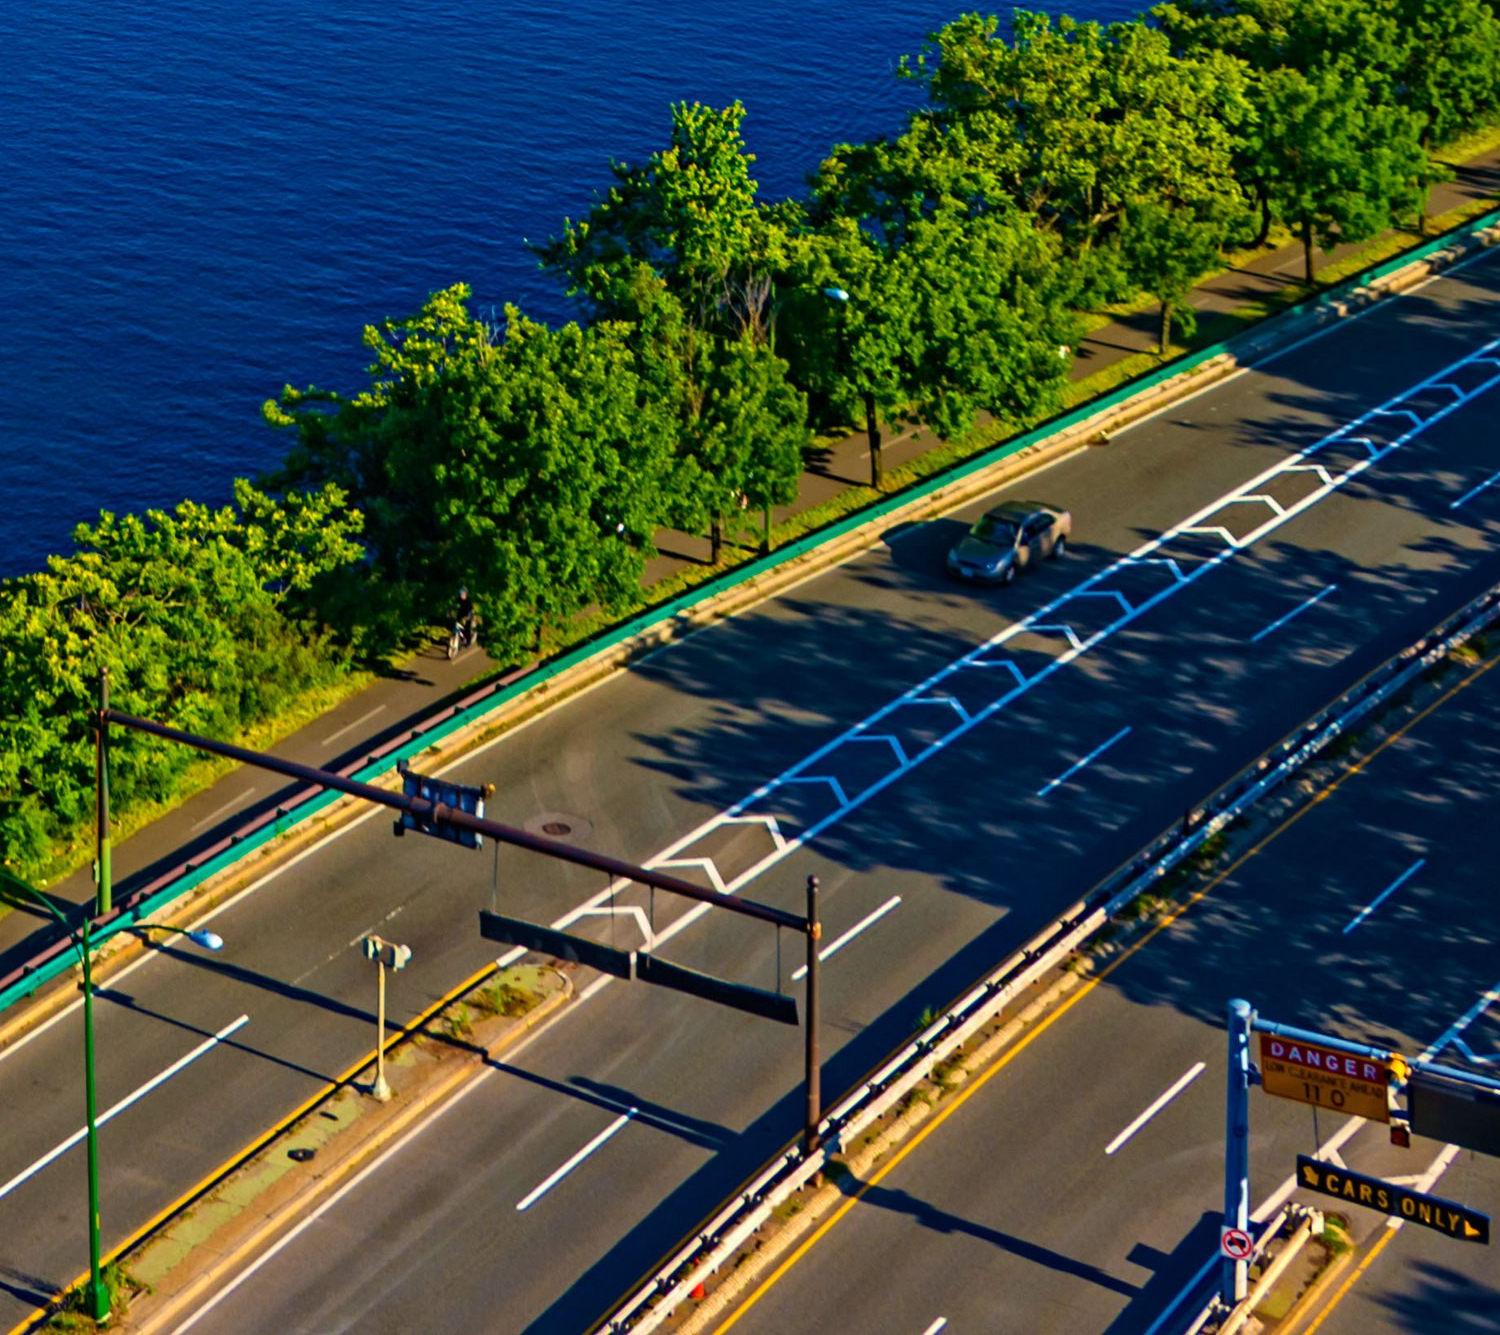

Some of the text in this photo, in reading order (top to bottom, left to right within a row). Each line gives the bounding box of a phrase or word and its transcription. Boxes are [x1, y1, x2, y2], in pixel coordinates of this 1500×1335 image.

[1270, 1042, 1377, 1080] DANGER
[1288, 1066, 1346, 1090] CLEARANCE
[1326, 1174, 1460, 1232] CARS ONLY
